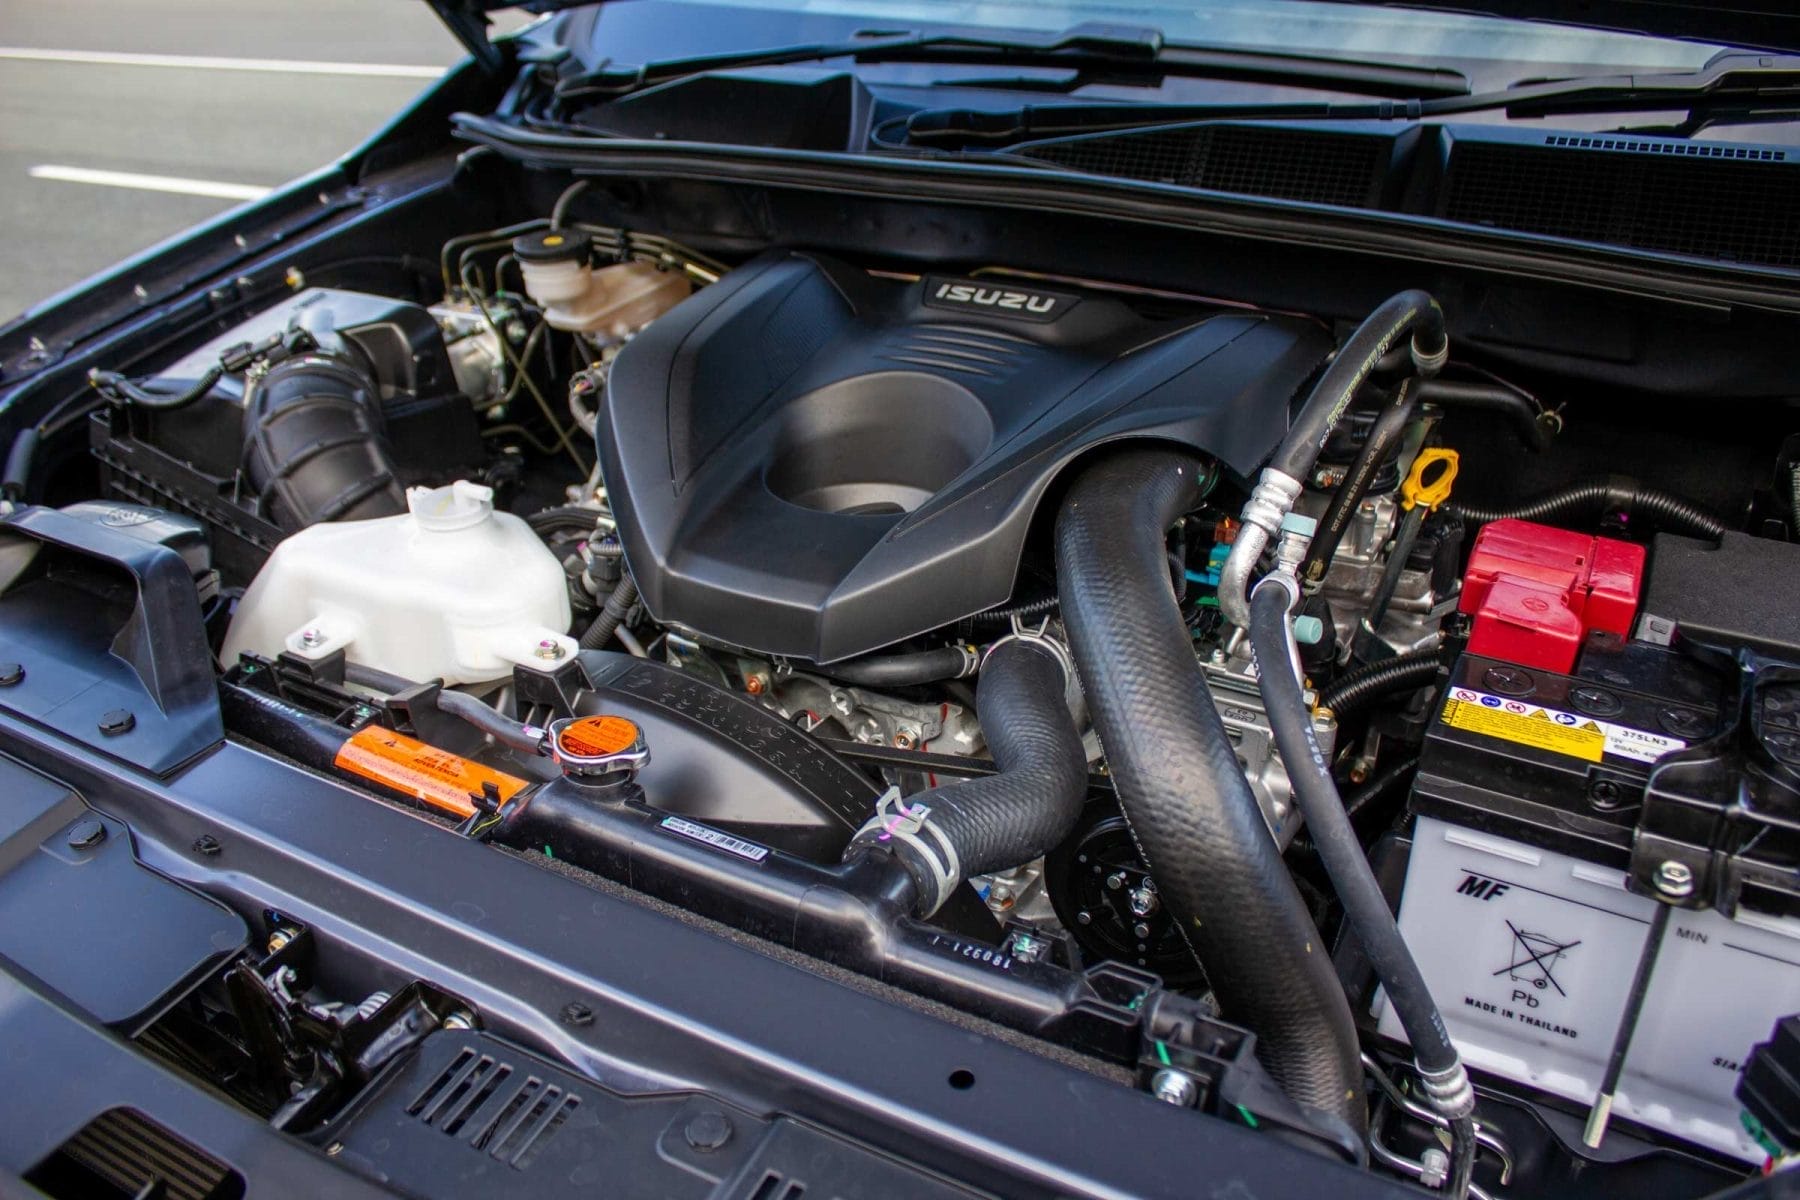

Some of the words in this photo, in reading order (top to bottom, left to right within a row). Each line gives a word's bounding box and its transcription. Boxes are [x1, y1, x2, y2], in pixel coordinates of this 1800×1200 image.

[935, 284, 1056, 313] ISUZU
[1622, 730, 1668, 747] 375LN3
[1456, 874, 1512, 902] MF
[1676, 927, 1709, 945] MIN
[1511, 989, 1540, 1009] Pb
[1464, 997, 1498, 1014] MADE
[1501, 1009, 1514, 1019] IN
[1519, 1014, 1578, 1039] THAILAND
[1712, 1056, 1741, 1072] SIA
